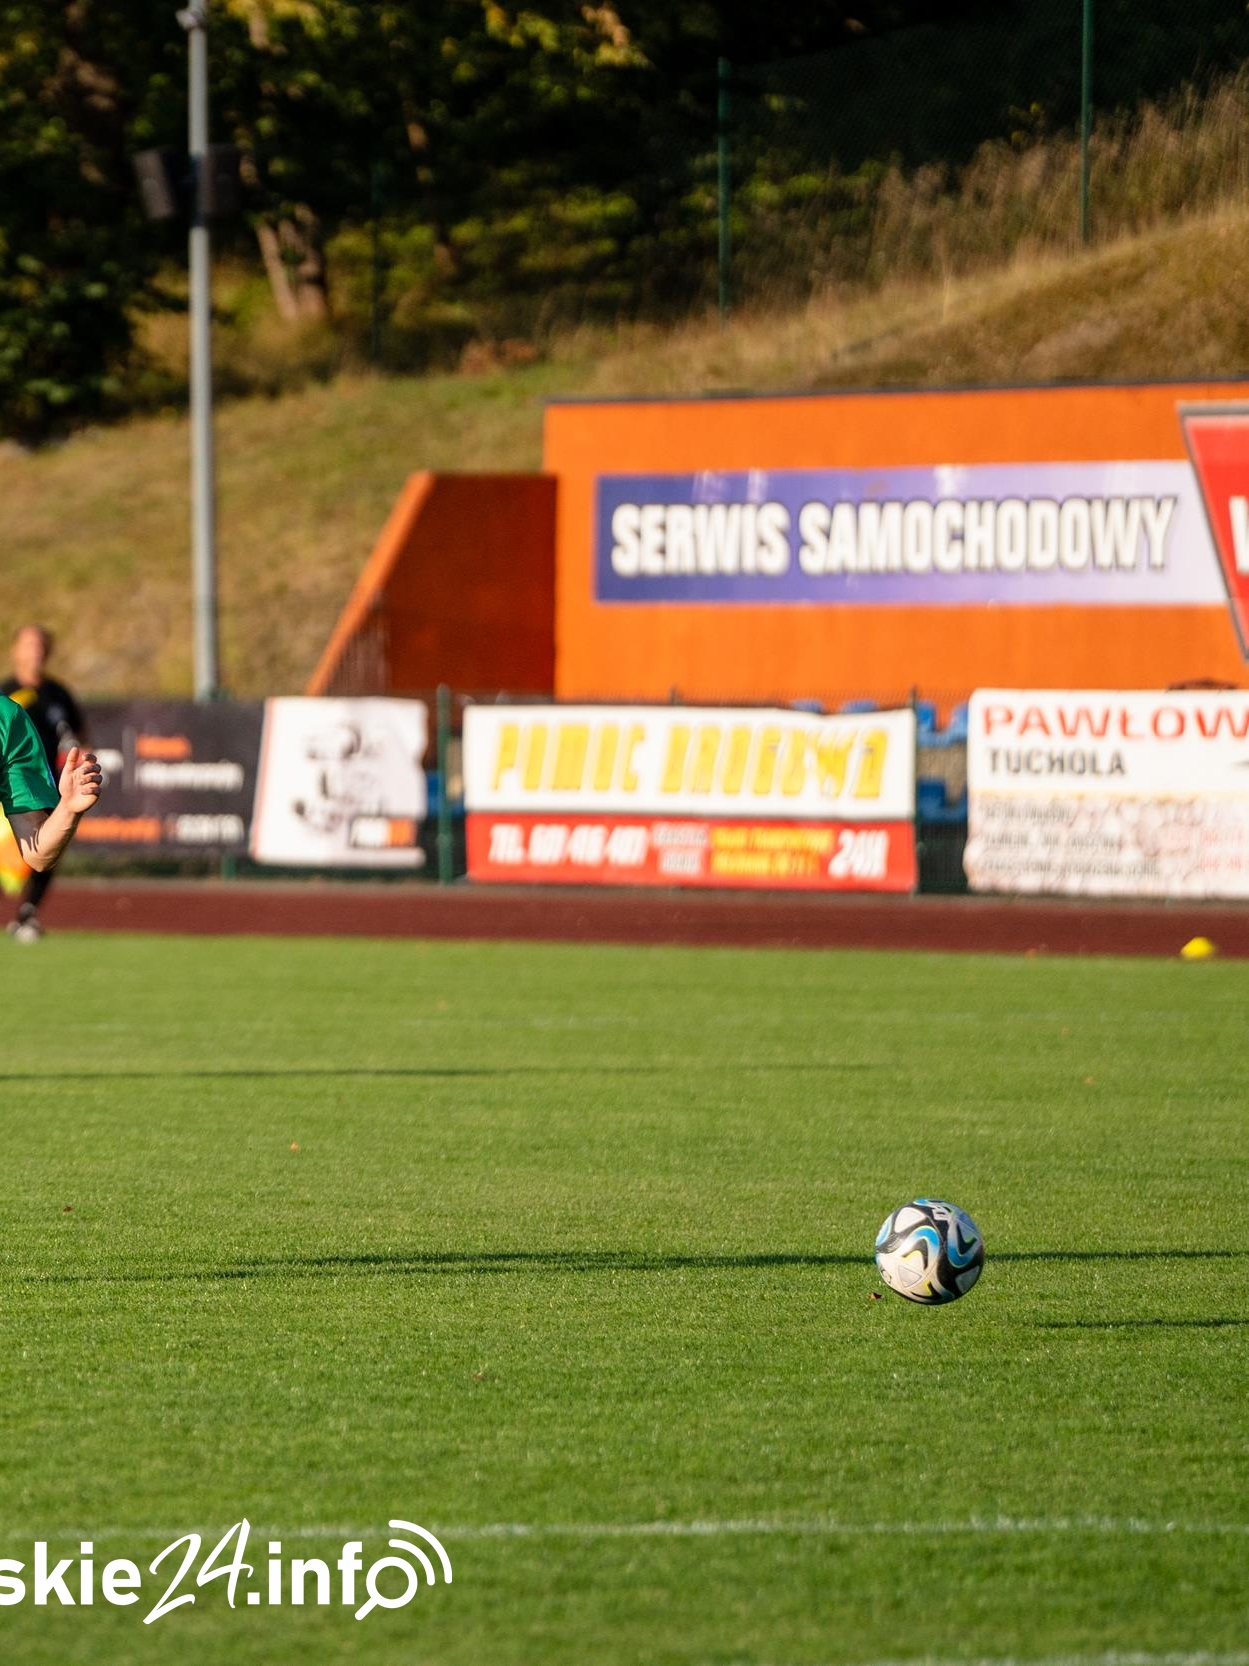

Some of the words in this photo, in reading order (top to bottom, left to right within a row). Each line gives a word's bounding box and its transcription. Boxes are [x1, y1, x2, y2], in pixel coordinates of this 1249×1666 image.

[611, 502, 791, 578] SERWIS
[798, 496, 1178, 576] SAMOCHODOWY
[988, 748, 1127, 777] TUCHOLA
